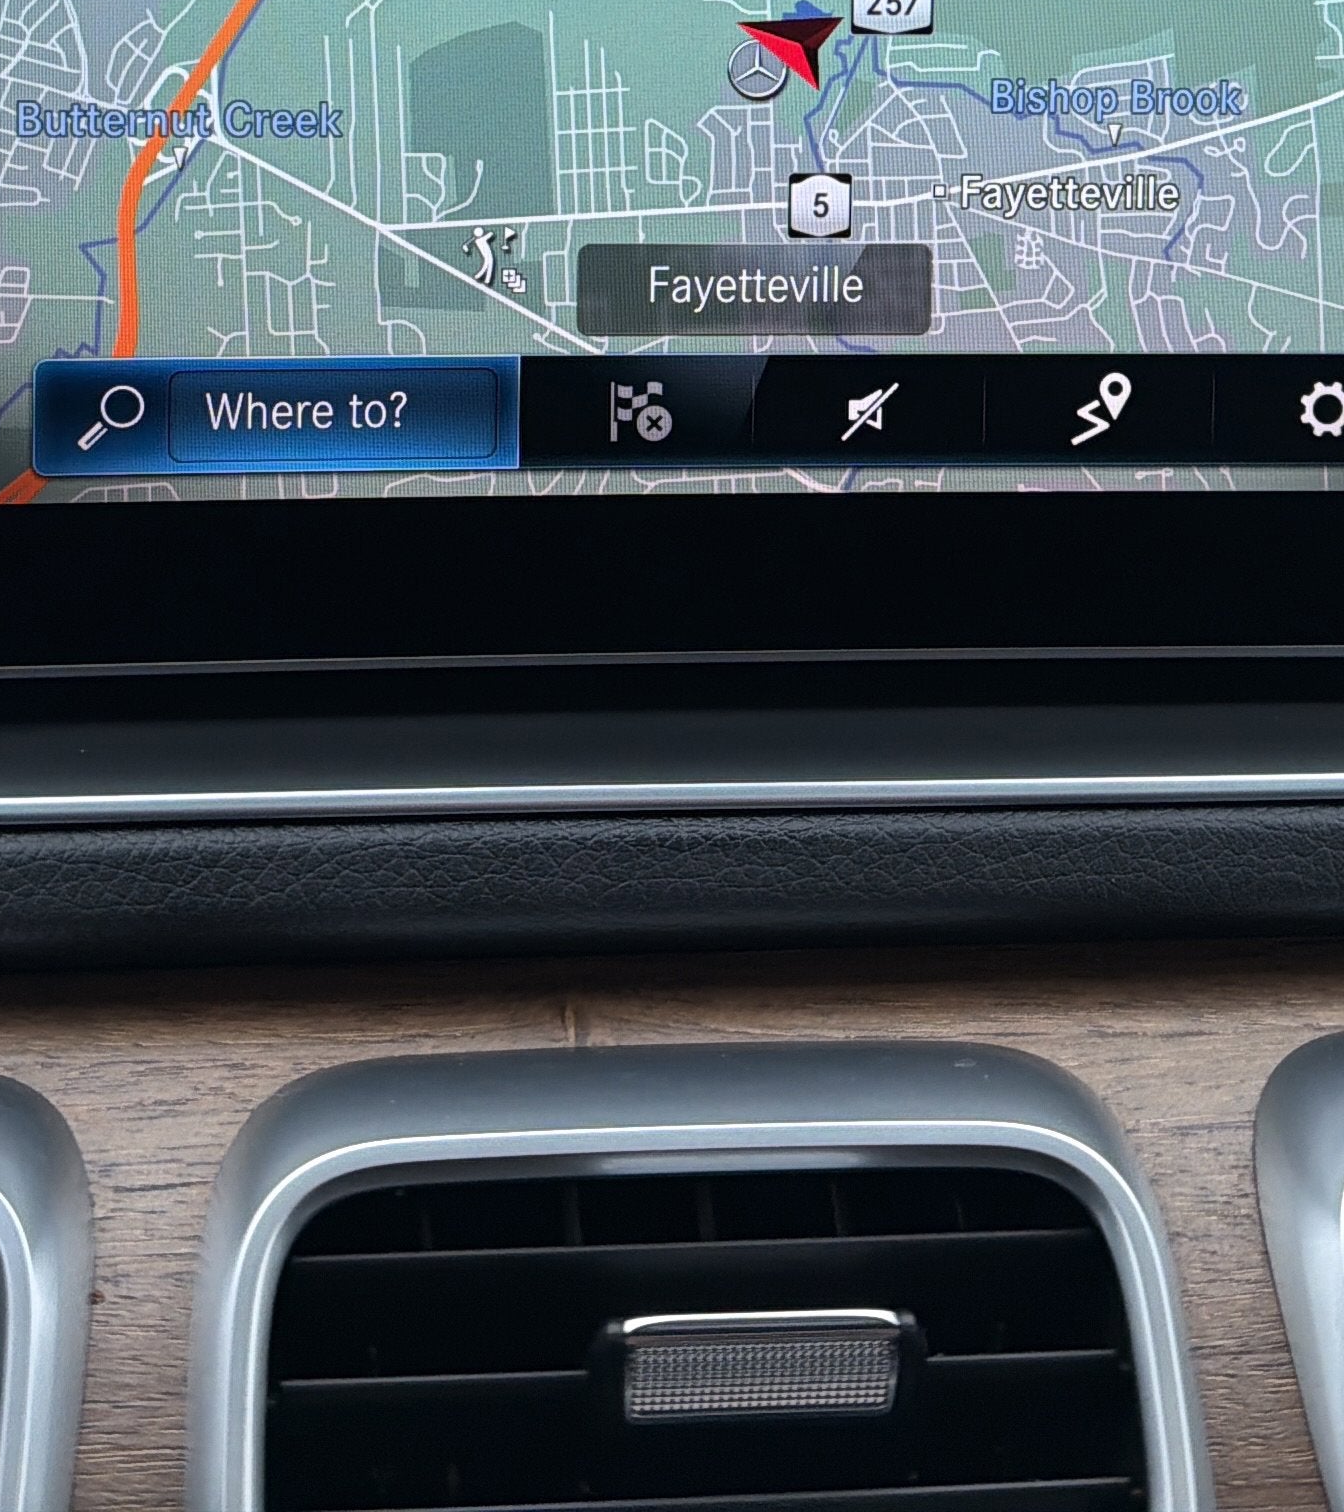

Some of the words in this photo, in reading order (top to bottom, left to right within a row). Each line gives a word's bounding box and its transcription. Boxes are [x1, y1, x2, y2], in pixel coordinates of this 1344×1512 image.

[16, 101, 212, 139] Butternut
[223, 102, 344, 139] Creek
[990, 78, 1118, 121] Bishop
[1132, 80, 1243, 116] Brook
[812, 191, 830, 219] 5
[959, 174, 1180, 215] Fayetteville
[649, 264, 865, 311] Fayetteville
[205, 390, 334, 432] Where
[350, 390, 408, 431] to?
